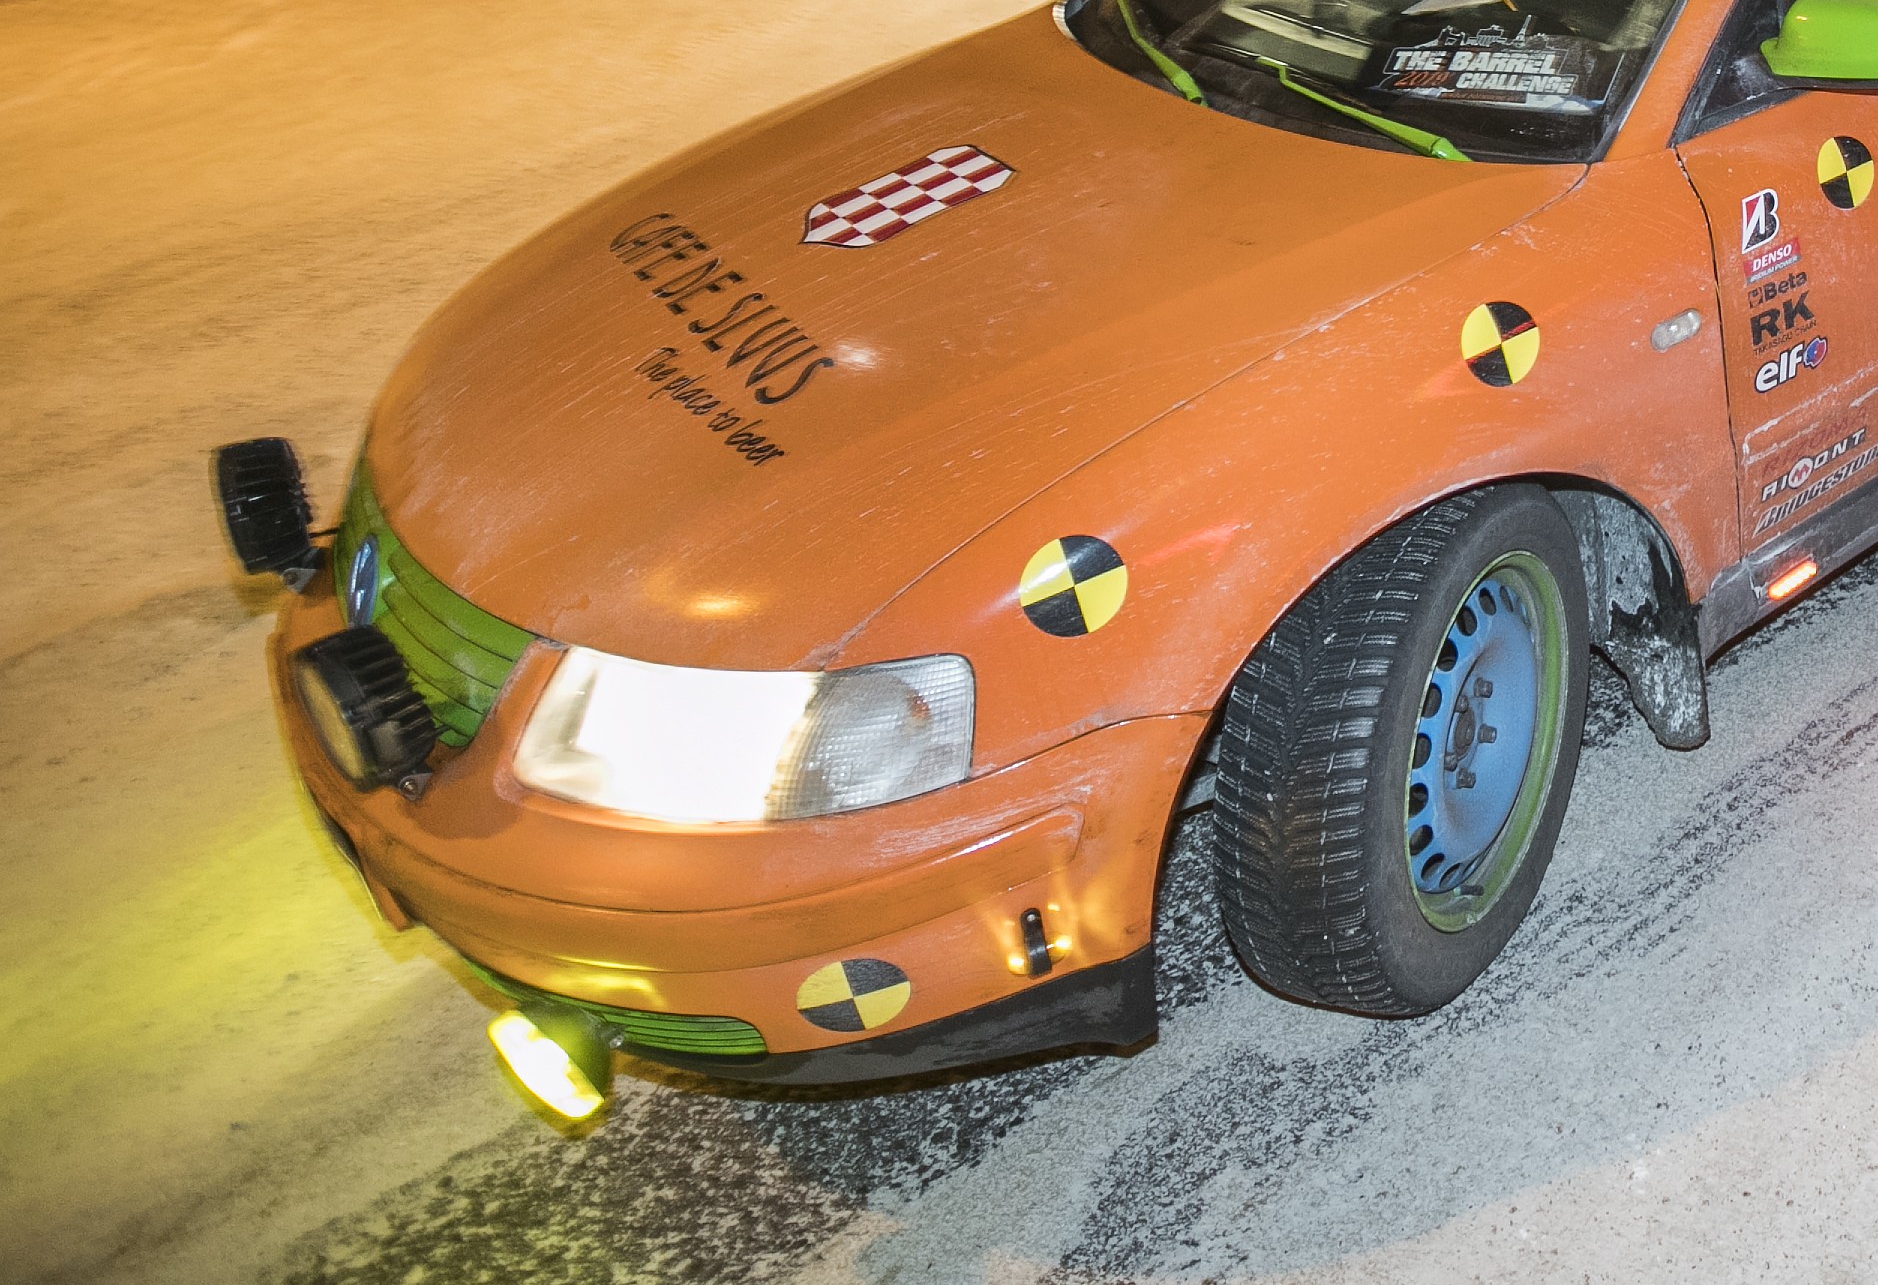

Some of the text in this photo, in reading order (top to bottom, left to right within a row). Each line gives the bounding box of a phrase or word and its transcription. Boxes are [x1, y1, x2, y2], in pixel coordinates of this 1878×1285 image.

[1392, 50, 1557, 74] THE BARREL
[1455, 72, 1576, 94] CHALLENGE
[1752, 244, 1792, 272] DENSO
[651, 257, 745, 315] DE
[1764, 271, 1808, 300] Beta
[1750, 290, 1815, 346] RK
[1755, 341, 1806, 393] elf
[634, 347, 785, 467] The place to beer
